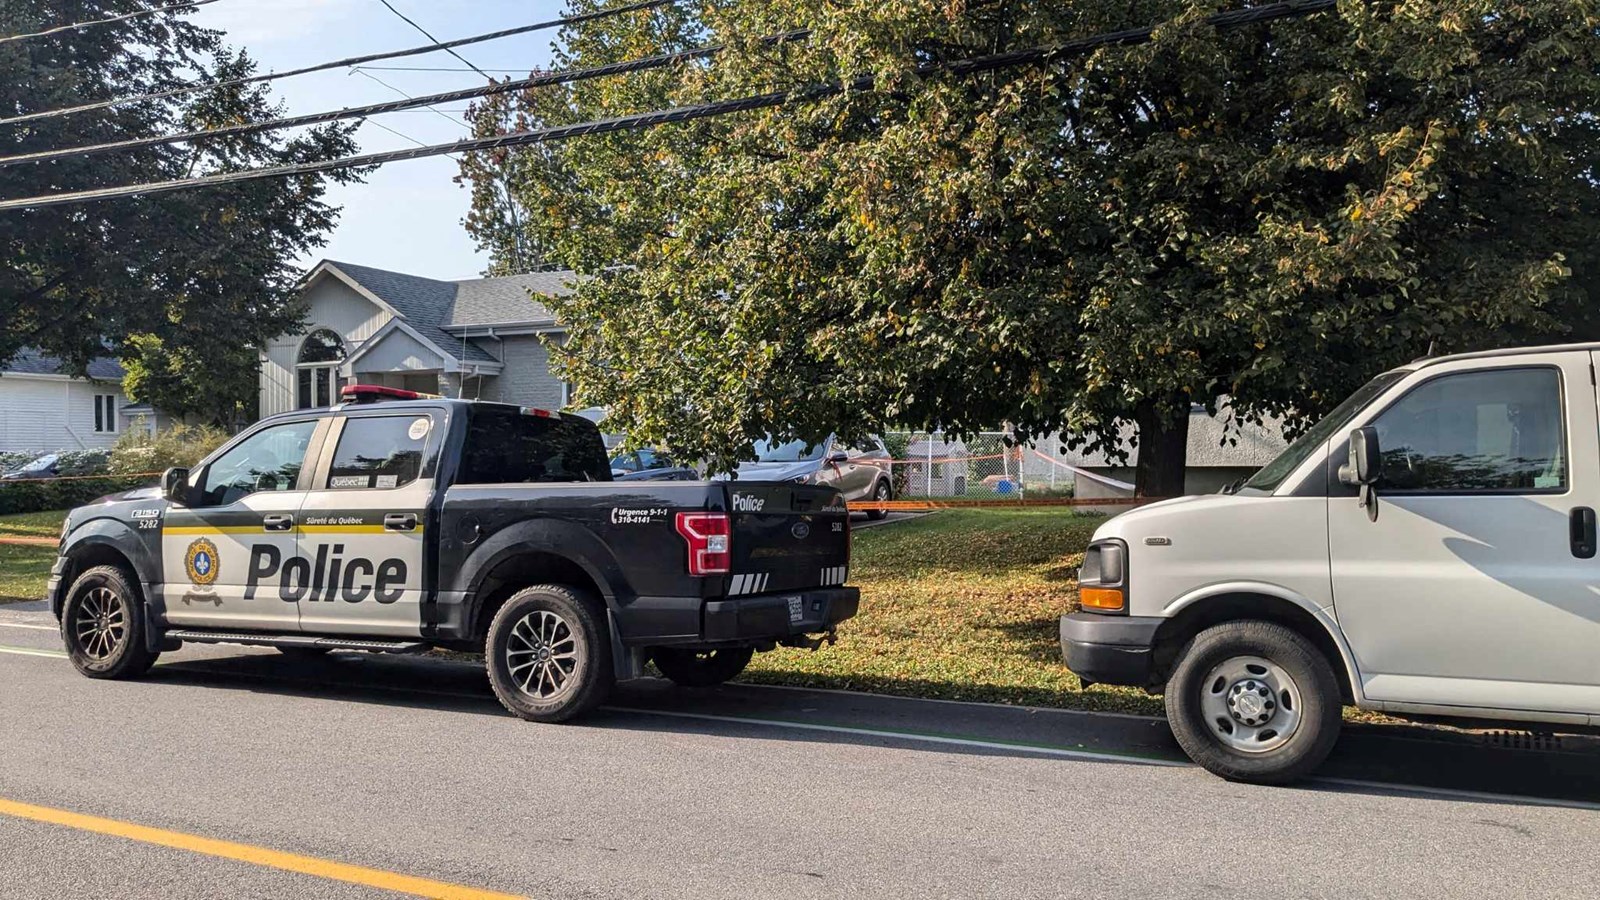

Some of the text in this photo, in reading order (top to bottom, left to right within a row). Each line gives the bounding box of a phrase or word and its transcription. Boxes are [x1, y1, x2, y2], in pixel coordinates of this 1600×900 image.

[732, 493, 765, 512] Police
[618, 508, 668, 518] Urgence 9-1-1
[138, 519, 158, 529] 5282
[306, 516, 363, 526] Sûreté du Québec
[617, 516, 650, 524] 310-4141
[243, 543, 407, 604] Police
